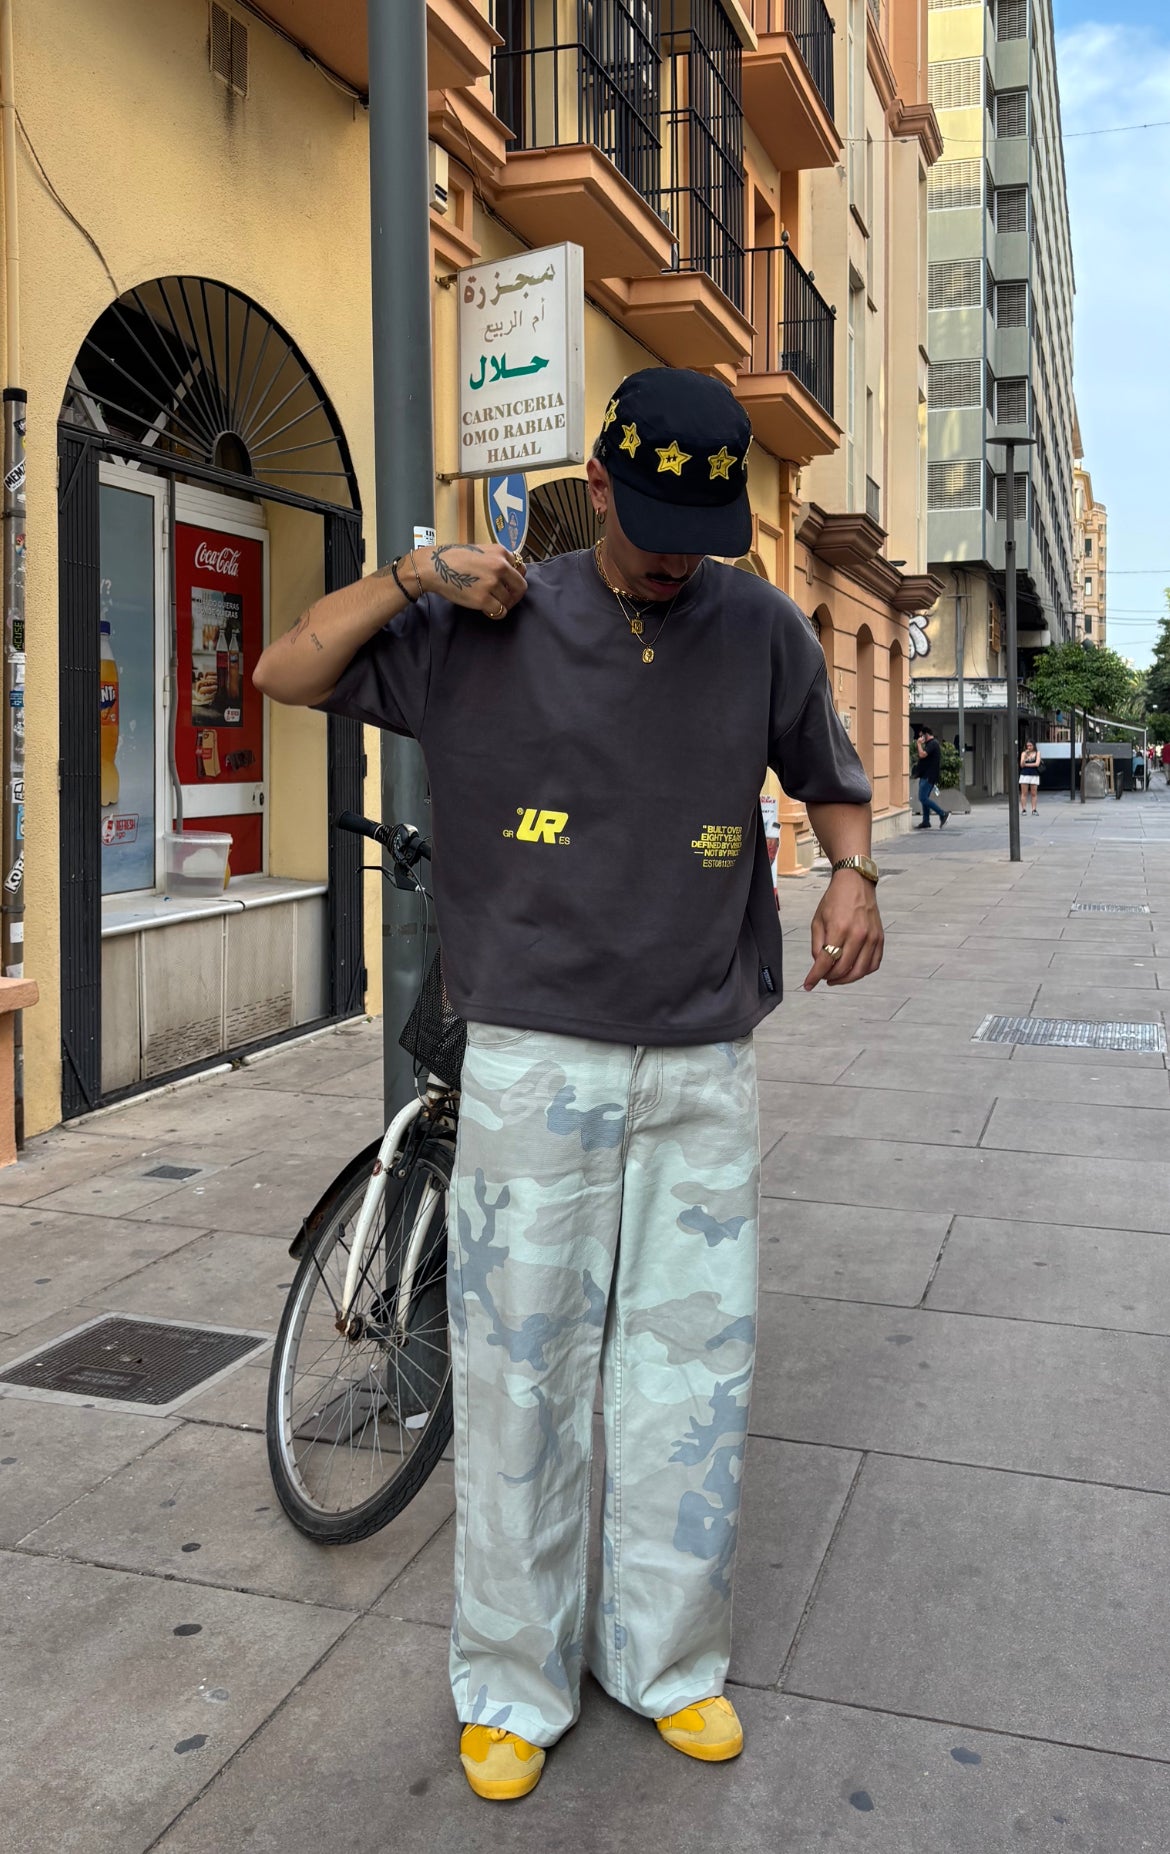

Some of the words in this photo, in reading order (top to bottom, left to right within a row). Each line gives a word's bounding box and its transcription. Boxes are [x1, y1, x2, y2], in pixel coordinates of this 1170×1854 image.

[464, 263, 556, 310] مجزرة
[484, 310, 523, 342] الربيع
[469, 352, 550, 390] حلال
[462, 392, 565, 426] CARNICERIA
[462, 427, 499, 447] OMO
[503, 413, 566, 440] RABIAE
[487, 441, 541, 464] HALAL
[195, 541, 241, 577] Coca-Cola
